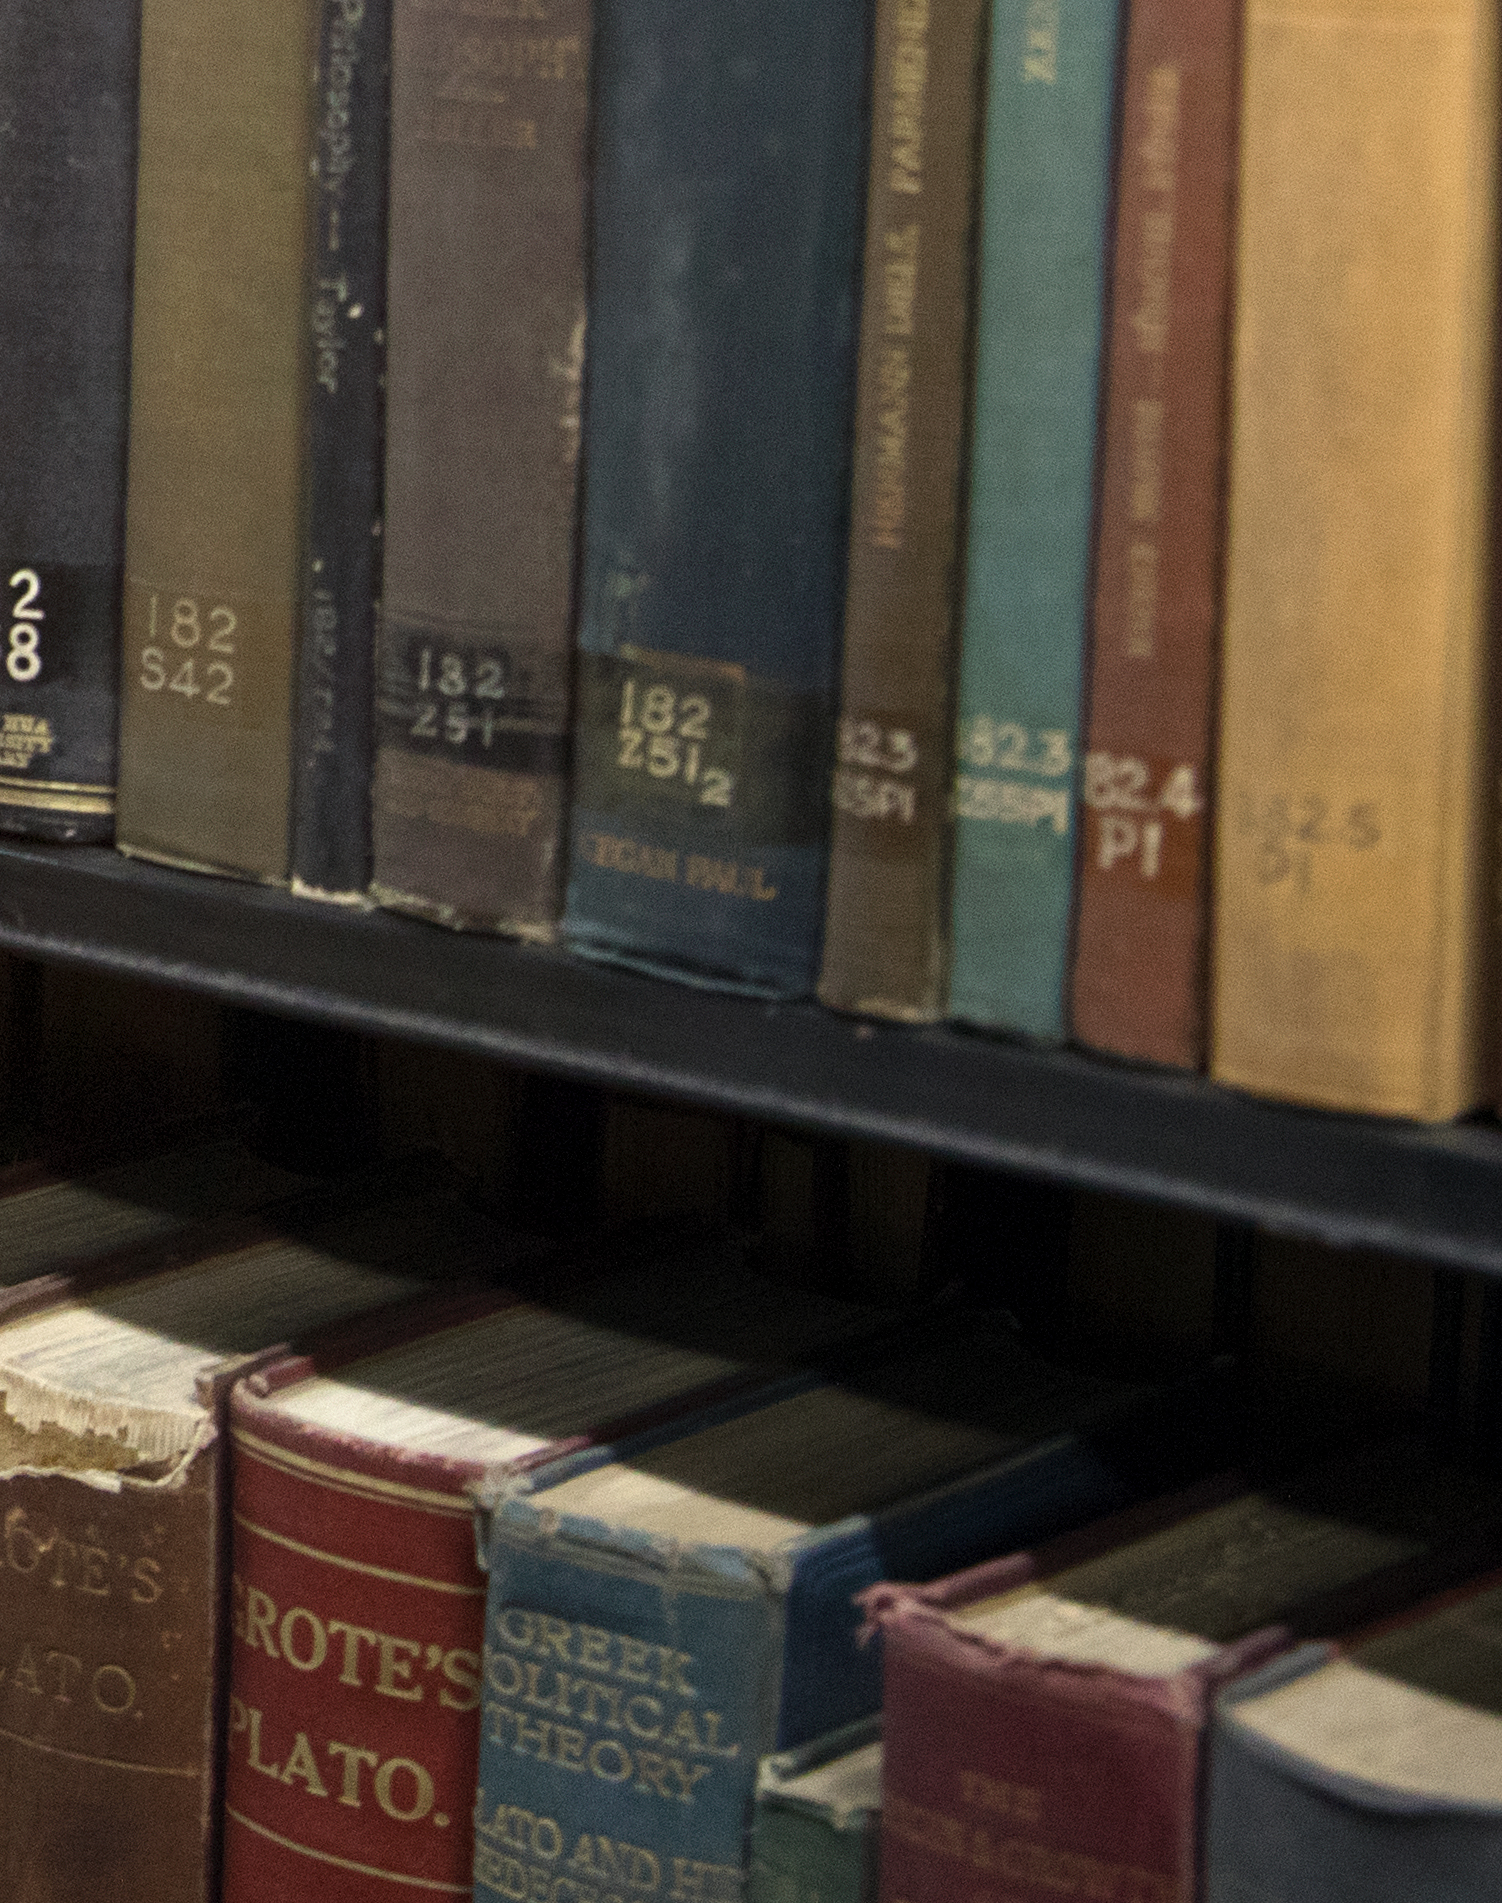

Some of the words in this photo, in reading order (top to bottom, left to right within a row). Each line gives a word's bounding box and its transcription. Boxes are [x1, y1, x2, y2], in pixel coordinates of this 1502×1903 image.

[146, 594, 238, 655] 182
[140, 648, 235, 705] S42
[418, 648, 506, 698] 182
[619, 679, 712, 741] 182
[496, 1605, 699, 1698] GREEK
[485, 1705, 711, 1806] THEORY
